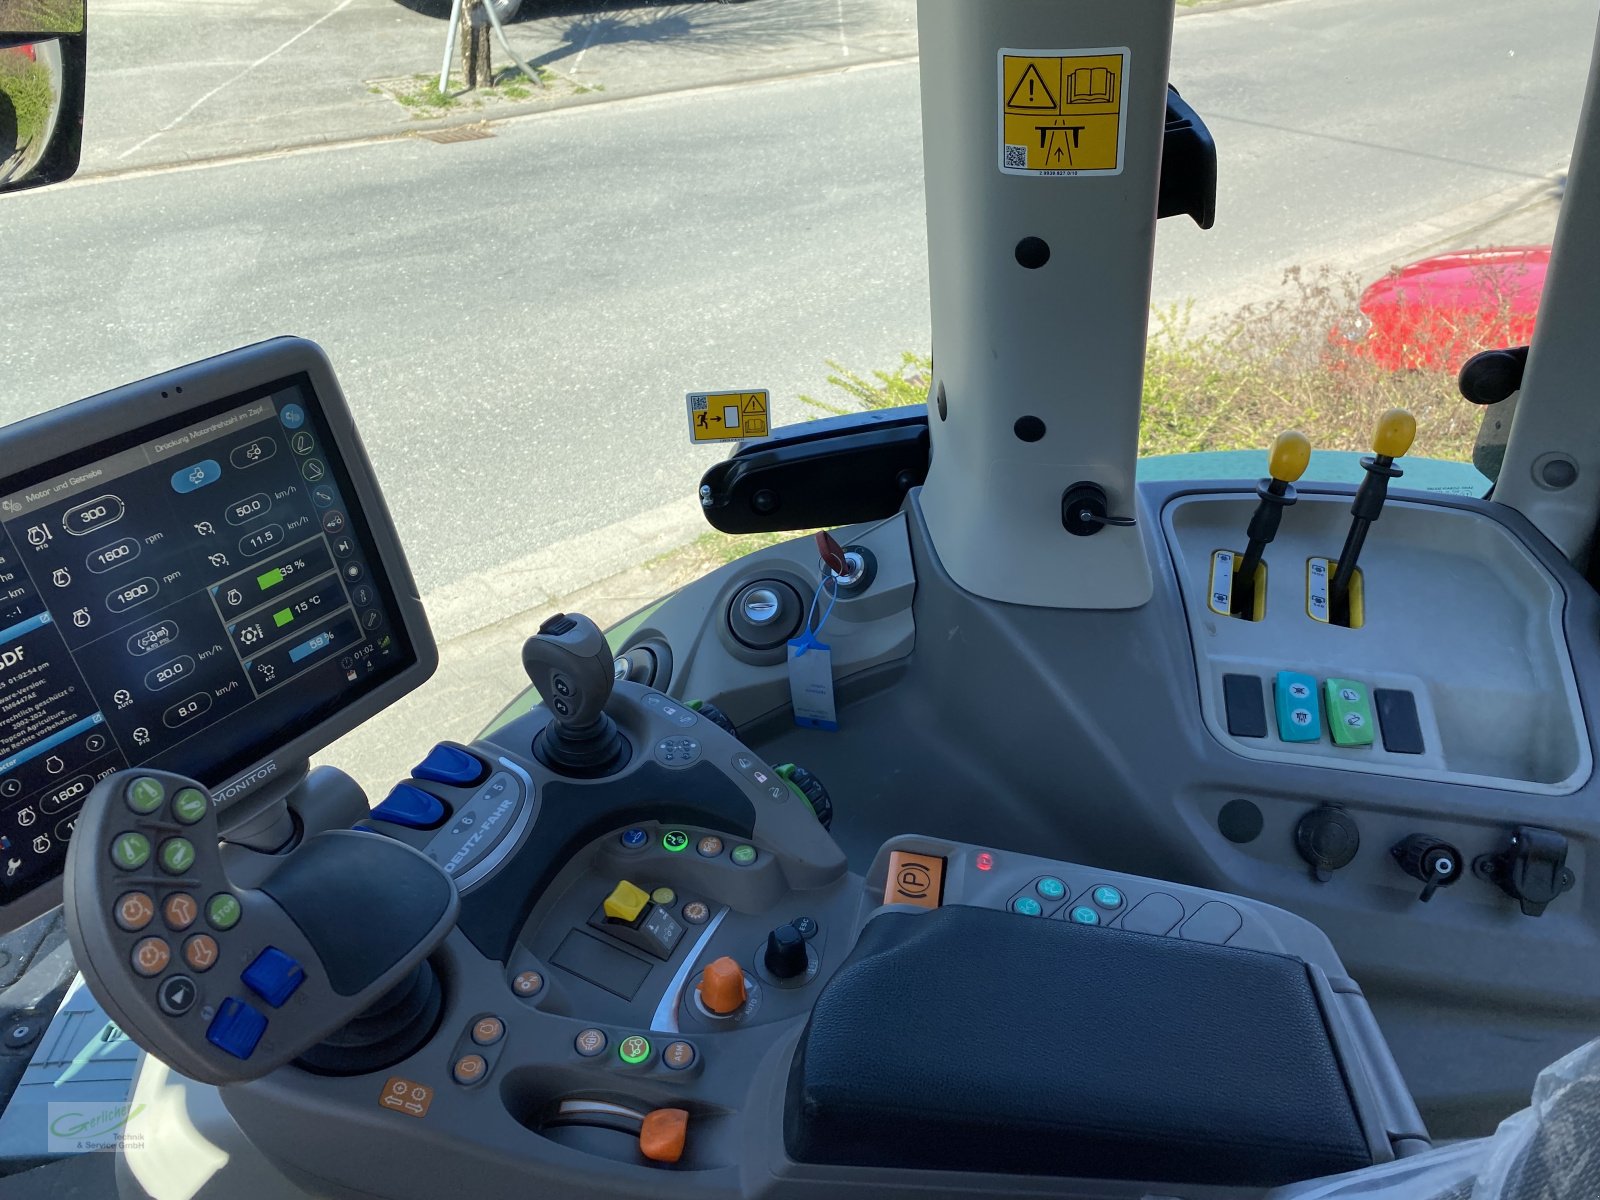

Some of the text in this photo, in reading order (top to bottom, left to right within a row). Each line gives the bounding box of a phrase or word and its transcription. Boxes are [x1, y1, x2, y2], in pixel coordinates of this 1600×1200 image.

[190, 416, 238, 439] Motordrehzahl
[239, 413, 248, 421] im
[25, 469, 103, 503] Motor und Getriebe
[235, 486, 297, 517] 50.0 km/h
[80, 506, 107, 523] 300
[250, 516, 309, 547] 11.5 km/h
[98, 532, 164, 564] 1600 rpm
[279, 559, 305, 577] 33 %
[8, 587, 25, 599] km
[117, 570, 181, 604] 1900 rpm
[295, 601, 309, 614] 15
[309, 631, 335, 649] 59 %
[354, 644, 375, 660] 01:02
[8, 667, 37, 684] 01:02:54
[37, 662, 50, 672] pm
[156, 644, 223, 682] 20.0 km/h
[34, 689, 69, 710] geschützt
[117, 699, 134, 710] AUTO
[178, 681, 239, 717] 8.0 km/h
[1, 710, 66, 745] Topcon Agriculture
[11, 734, 36, 750] Rechte
[35, 713, 78, 737] vorbehalten
[12, 709, 47, 730] 2002-2024
[52, 766, 117, 804] 1600 rpm
[212, 762, 277, 807] MONITOR
[443, 799, 513, 873] DEUTZ-FAHR
[212, 900, 235, 923] STOP
[799, 919, 809, 931] ESC
[674, 1044, 685, 1062] ASM
